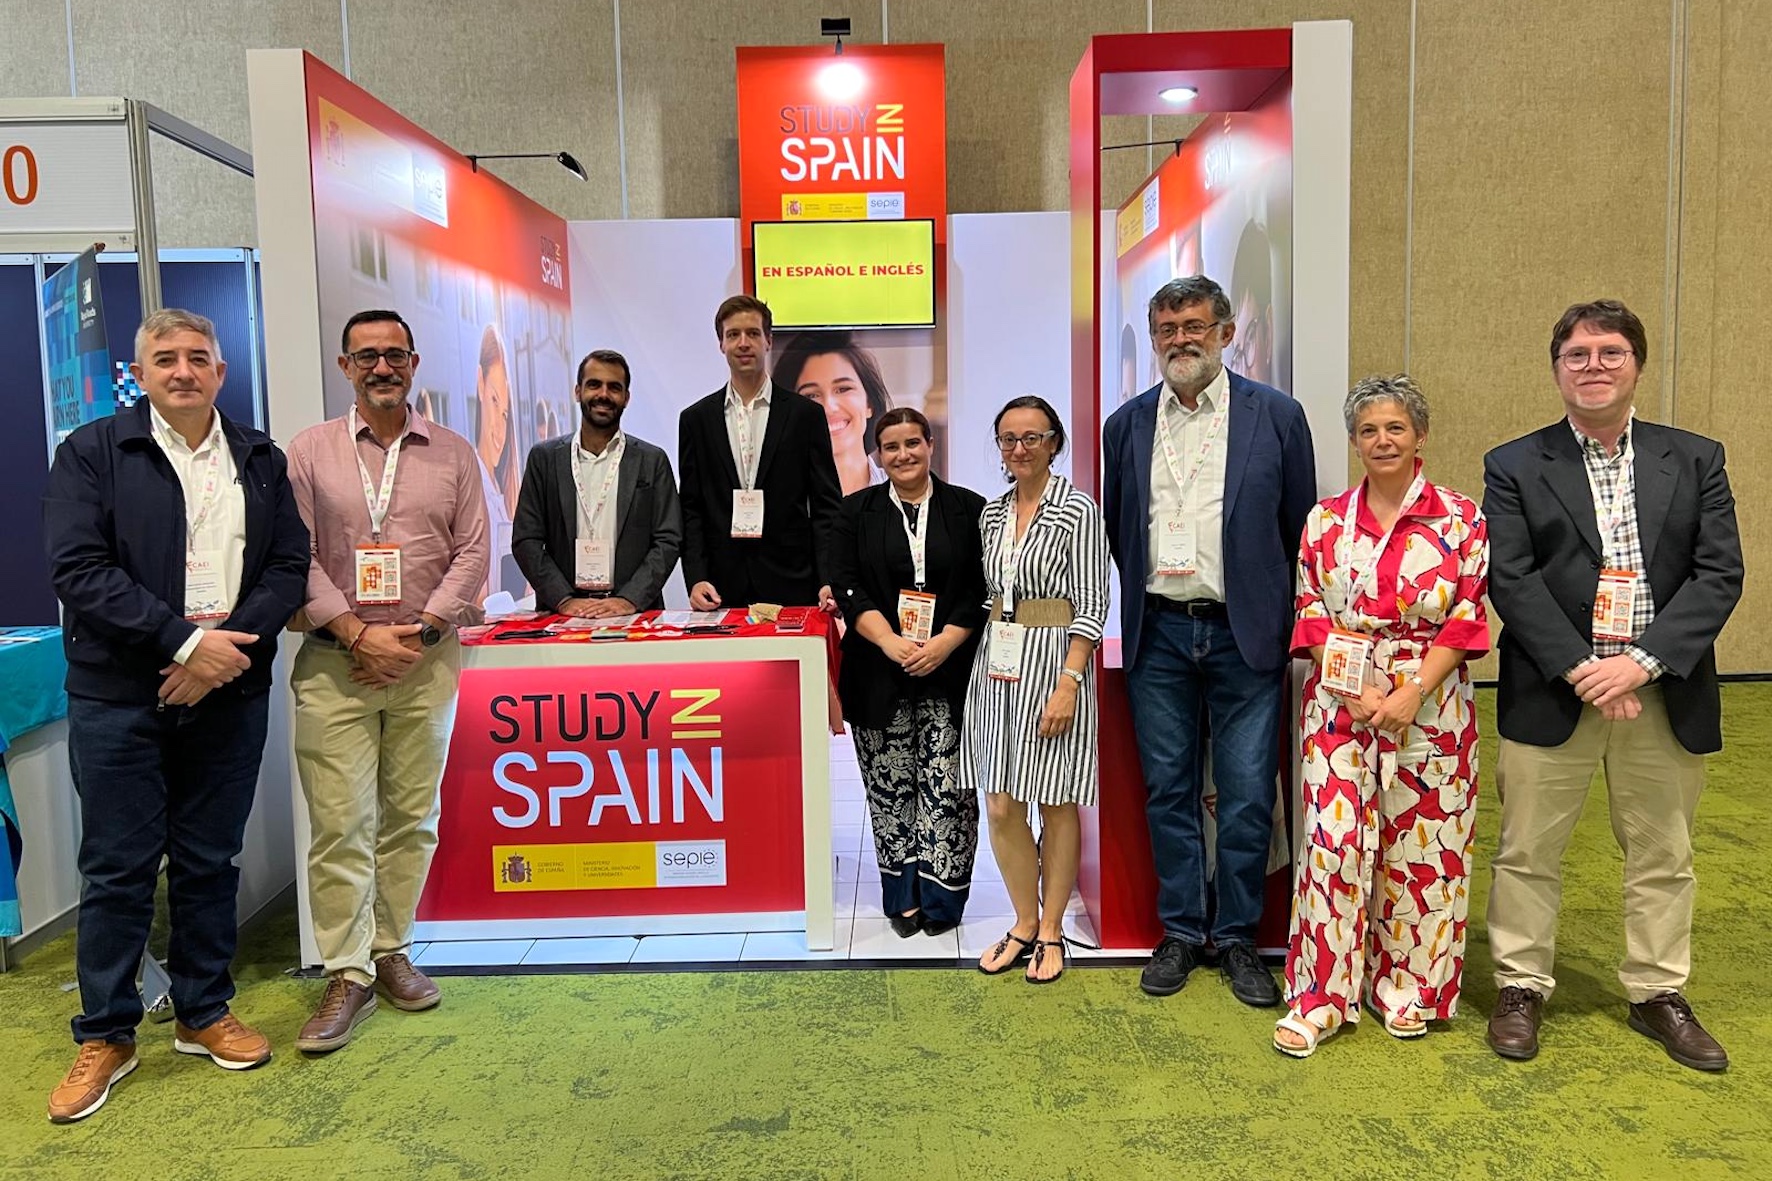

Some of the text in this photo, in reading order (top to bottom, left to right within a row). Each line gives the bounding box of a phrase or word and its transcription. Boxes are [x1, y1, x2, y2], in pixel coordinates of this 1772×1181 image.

[780, 104, 904, 134] STUDY IN
[781, 136, 905, 181] SPAIN
[870, 199, 899, 209] sepie
[541, 255, 563, 290] SPAIN
[762, 262, 924, 277] EN ESPAÑOL E INGLÉS
[489, 688, 722, 743] STUDY IN
[492, 746, 724, 829] SPAIN
[663, 851, 716, 869] sepie
